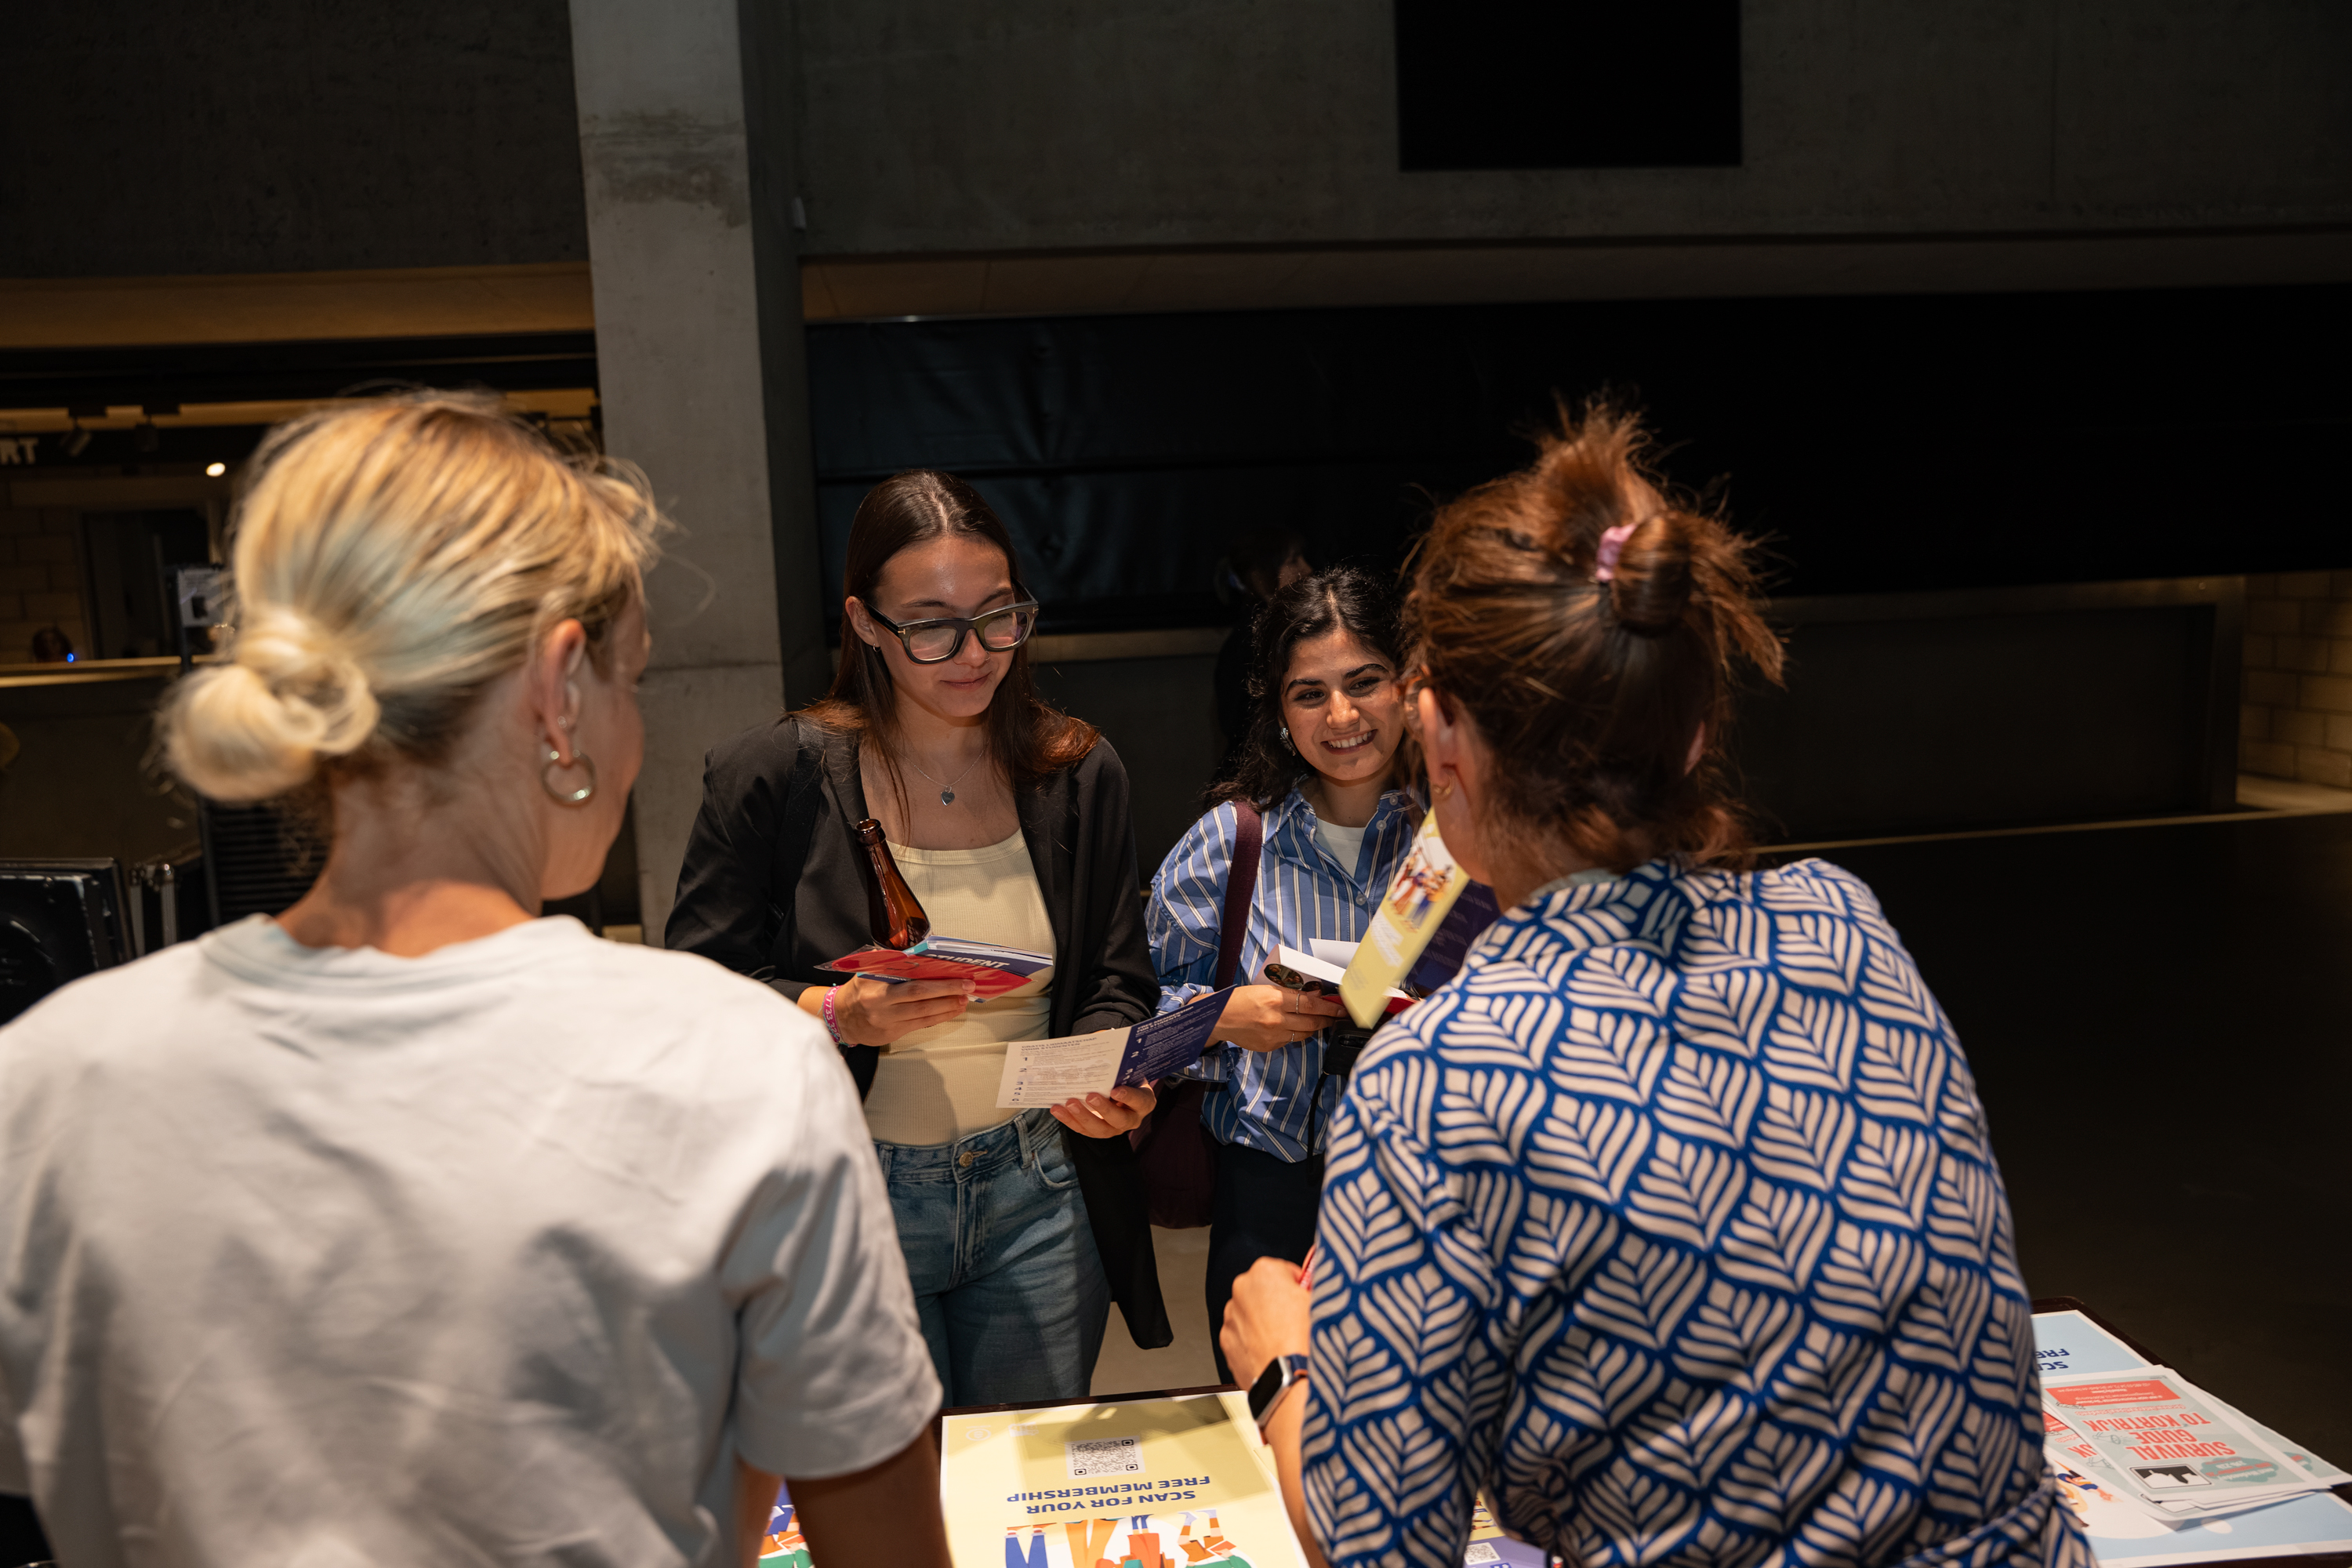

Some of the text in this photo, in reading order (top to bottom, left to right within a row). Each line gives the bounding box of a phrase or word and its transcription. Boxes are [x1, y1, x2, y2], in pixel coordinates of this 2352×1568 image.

[2036, 1348, 2071, 1359] FRE
[2038, 1361, 2070, 1371] SC
[2082, 1414, 2181, 1432] KORTRIJK
[2179, 1412, 2212, 1425] TO
[2129, 1429, 2198, 1444] GUIDE
[2125, 1441, 2236, 1461] SURVIVAL
[1007, 1475, 1210, 1502] FREE MEMBERSHIP
[1026, 1490, 1196, 1514] SCAN FOR YOUR
